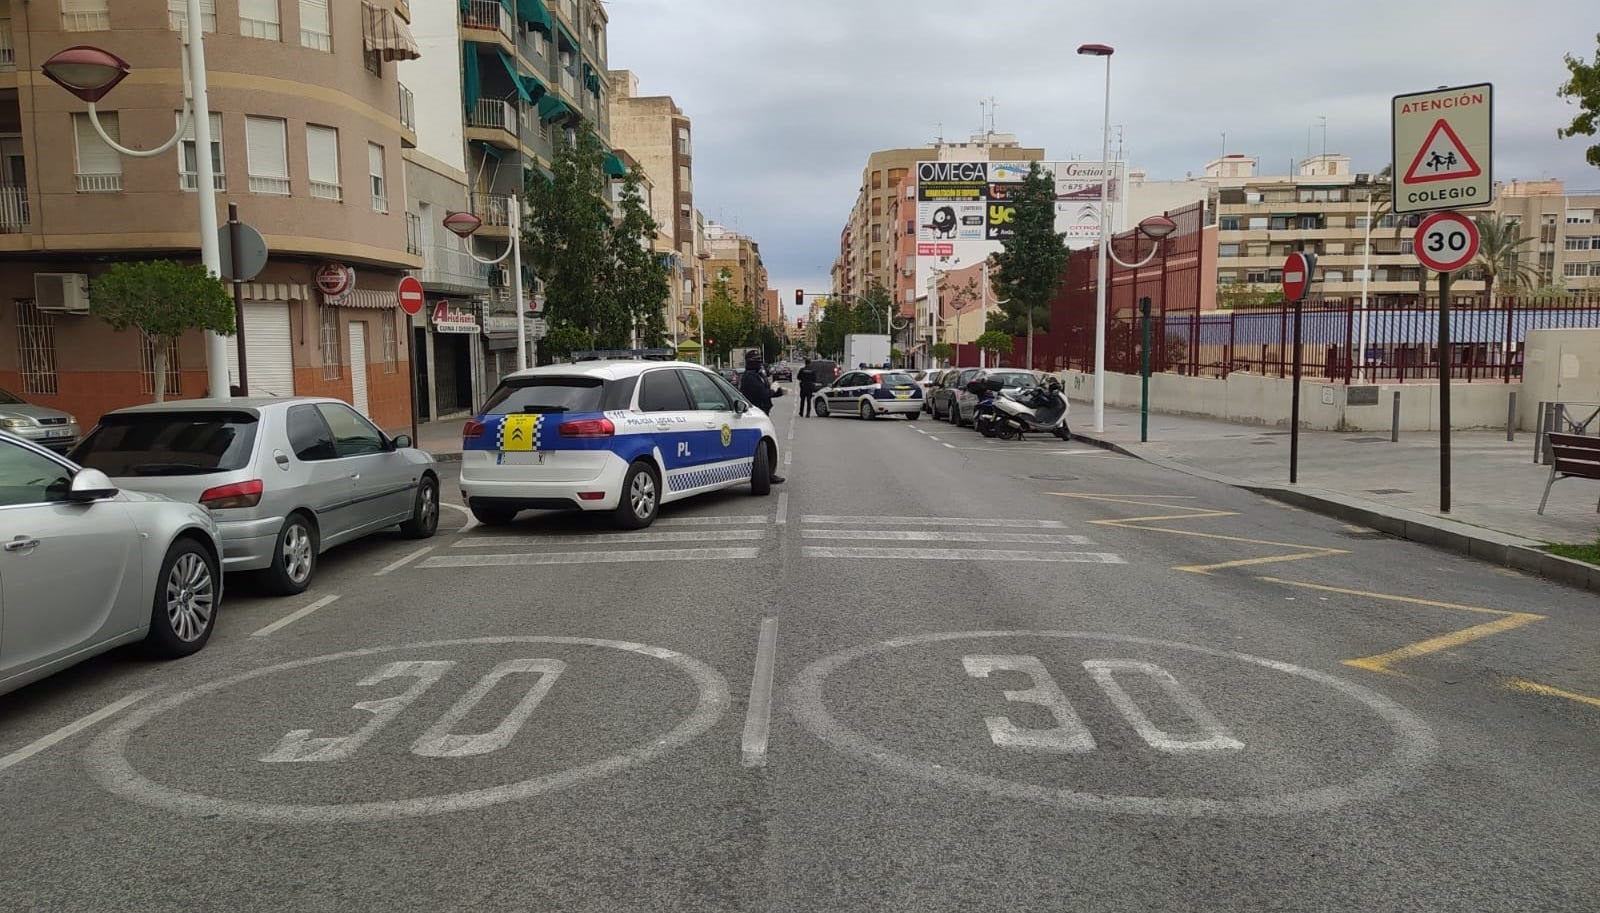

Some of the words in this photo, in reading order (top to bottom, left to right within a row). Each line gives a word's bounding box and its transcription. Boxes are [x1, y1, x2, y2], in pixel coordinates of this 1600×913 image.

[1401, 92, 1484, 114] ATENCIÓN
[919, 163, 986, 181] OMEGA
[1407, 185, 1477, 204] COLEGIO
[1428, 231, 1467, 252] 30
[677, 442, 691, 457] PL
[259, 658, 568, 764] 30
[962, 655, 1246, 755] 30
